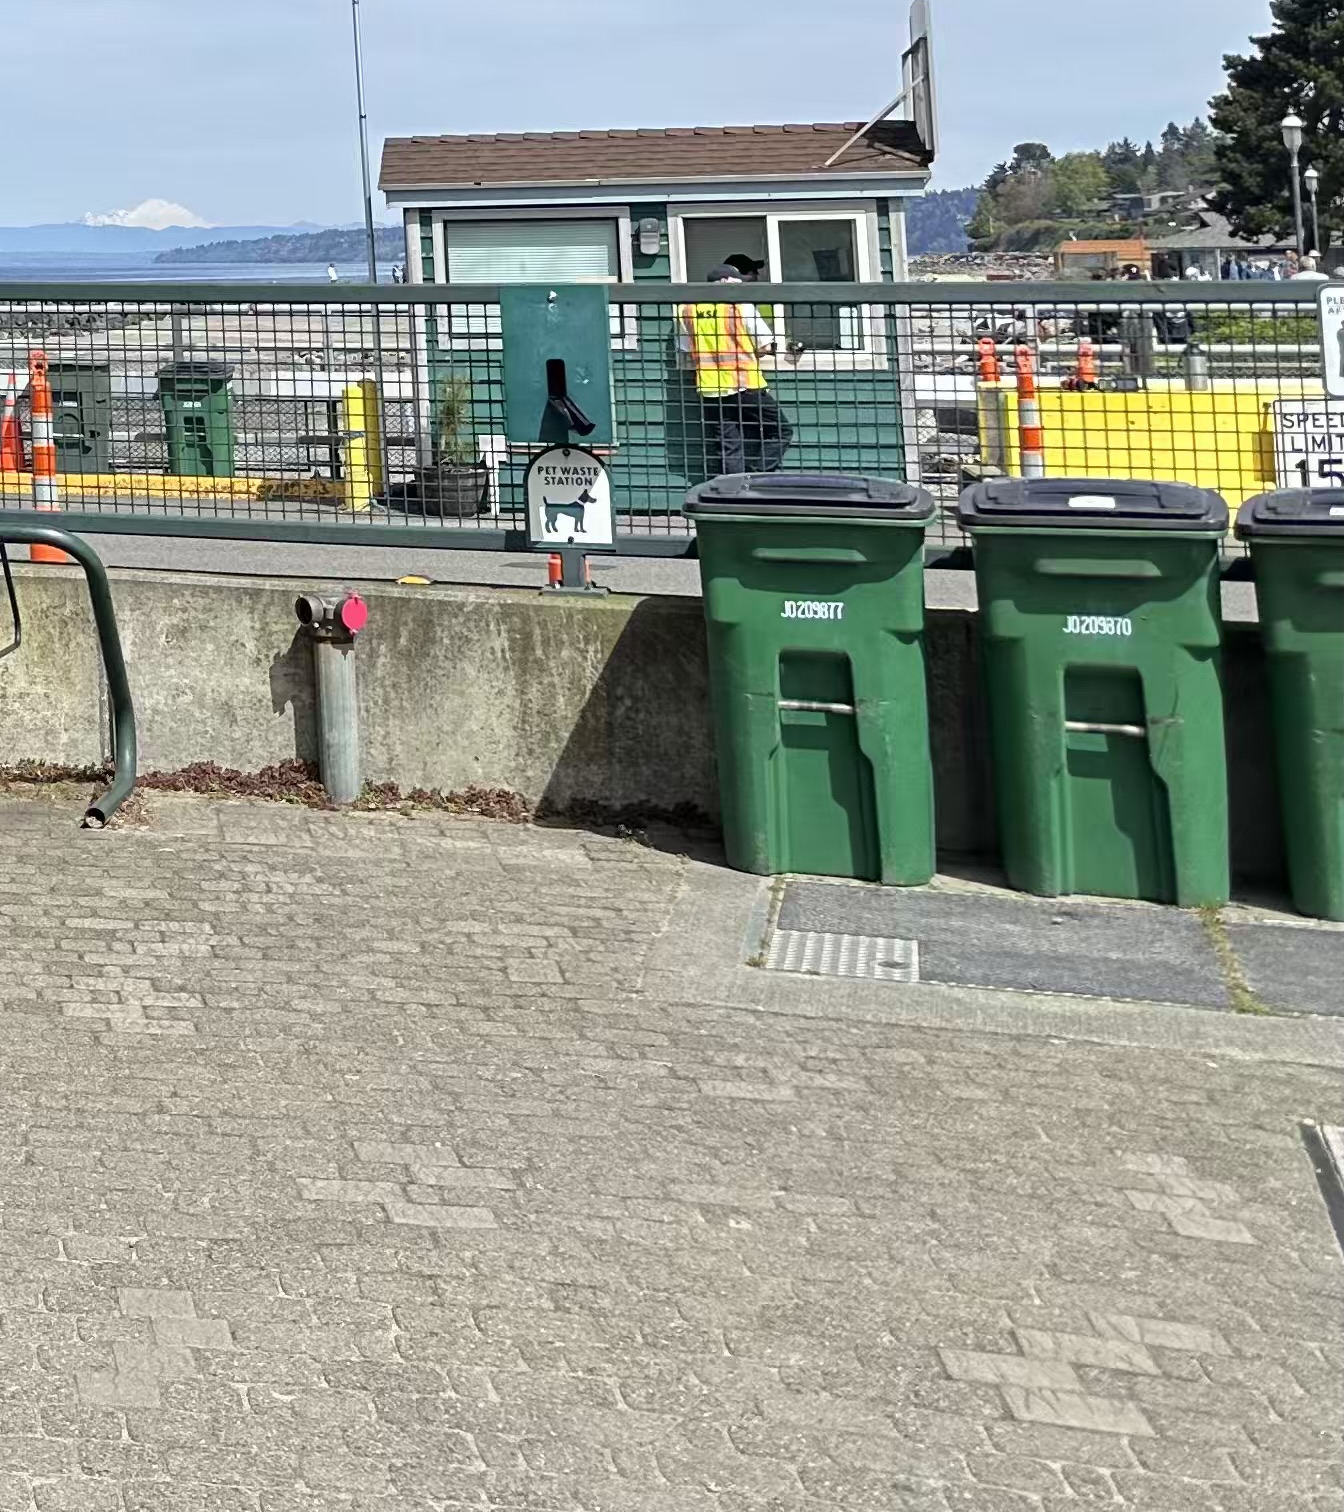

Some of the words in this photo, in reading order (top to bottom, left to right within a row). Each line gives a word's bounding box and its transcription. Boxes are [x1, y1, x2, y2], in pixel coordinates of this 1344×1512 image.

[538, 466, 560, 476] PET
[562, 466, 598, 476] WASTE
[544, 476, 592, 486] STATION
